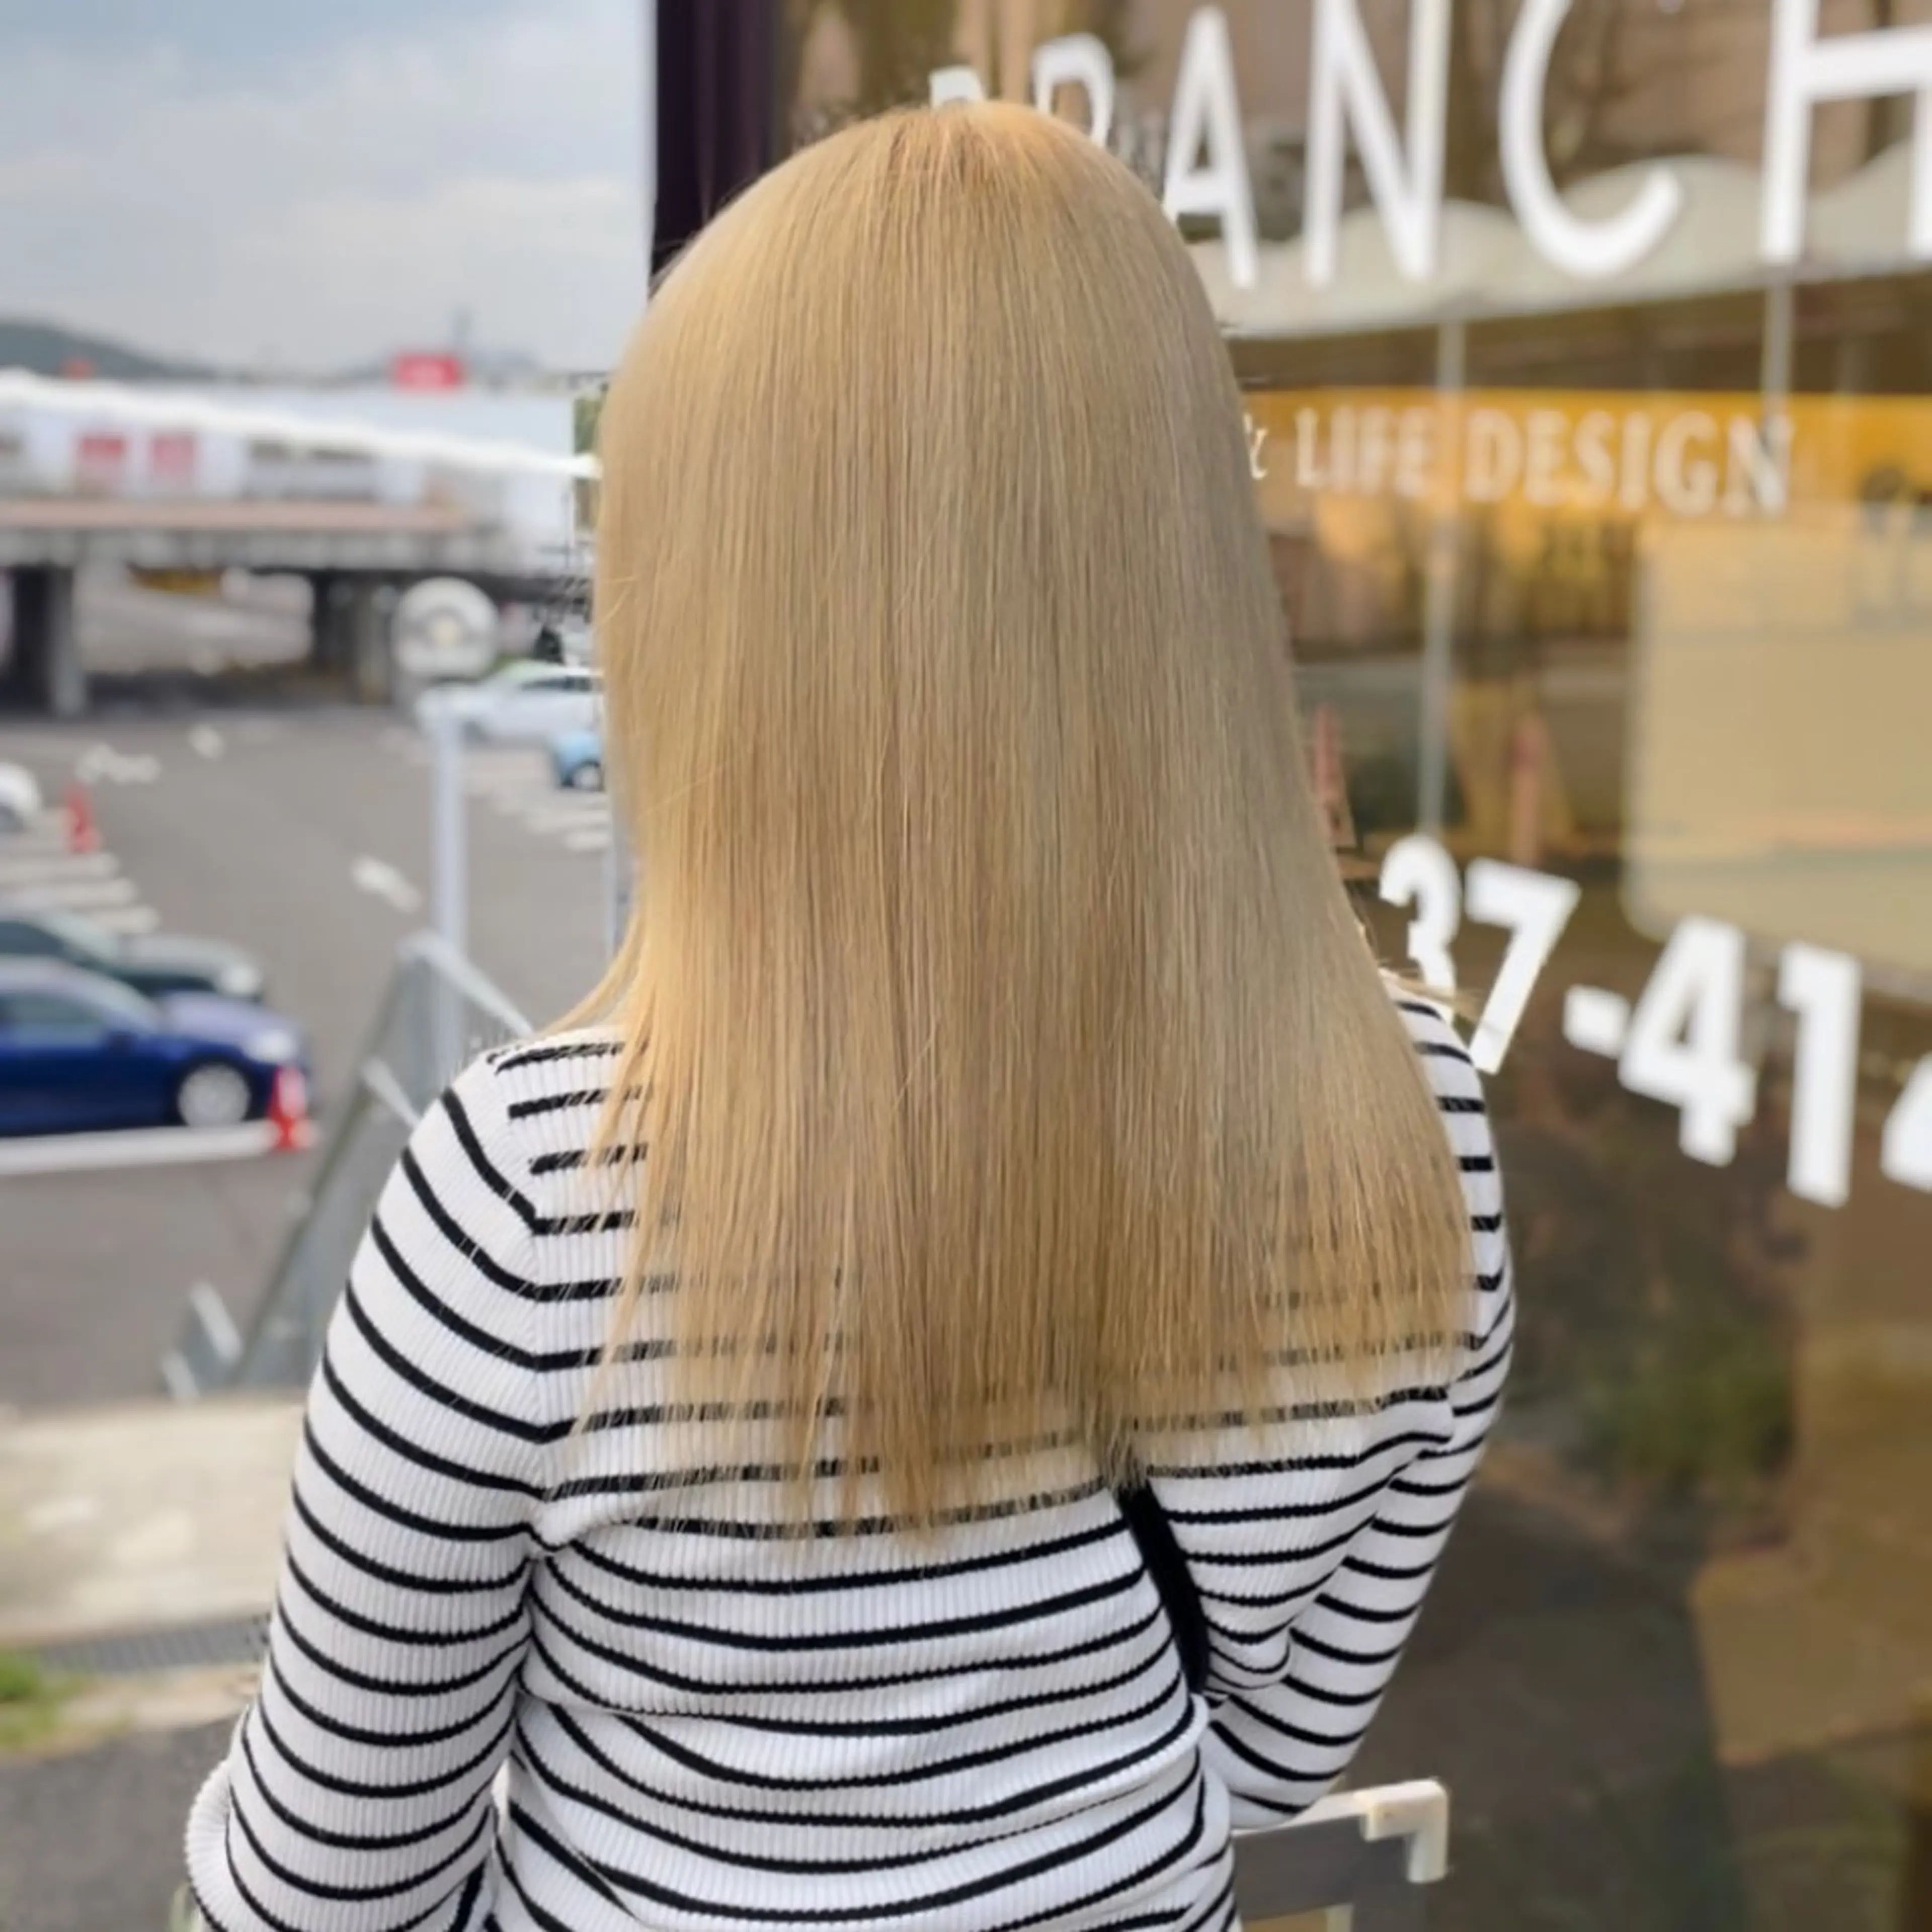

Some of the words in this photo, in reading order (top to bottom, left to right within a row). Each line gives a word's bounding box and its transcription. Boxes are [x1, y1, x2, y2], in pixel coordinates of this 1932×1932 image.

[928, 0, 1932, 288] ANCH
[1296, 408, 1433, 497] LIFE
[1459, 409, 1794, 517] DESIGN
